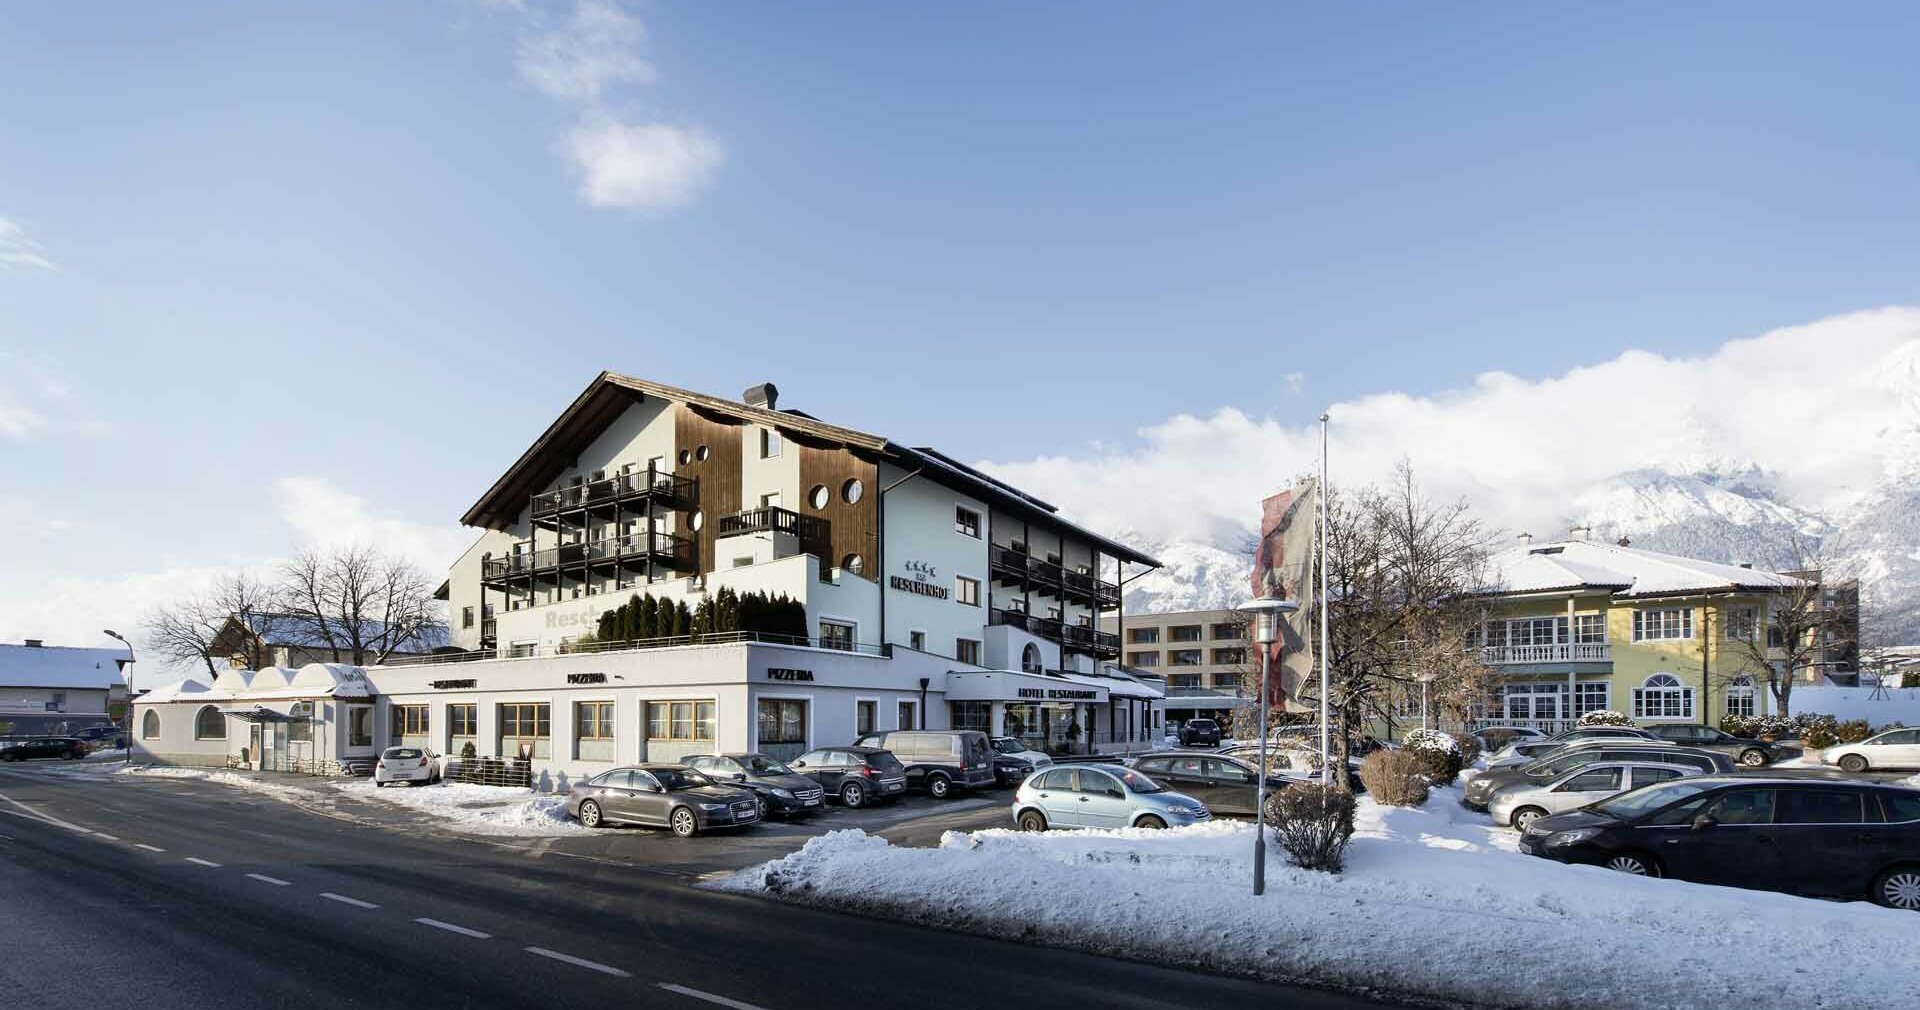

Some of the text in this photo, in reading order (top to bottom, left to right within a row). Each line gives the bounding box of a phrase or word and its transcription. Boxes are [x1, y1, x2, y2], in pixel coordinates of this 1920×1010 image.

[768, 668, 815, 681] PIZZERIA
[1019, 687, 1097, 700] HOTEL RESTAURANT
